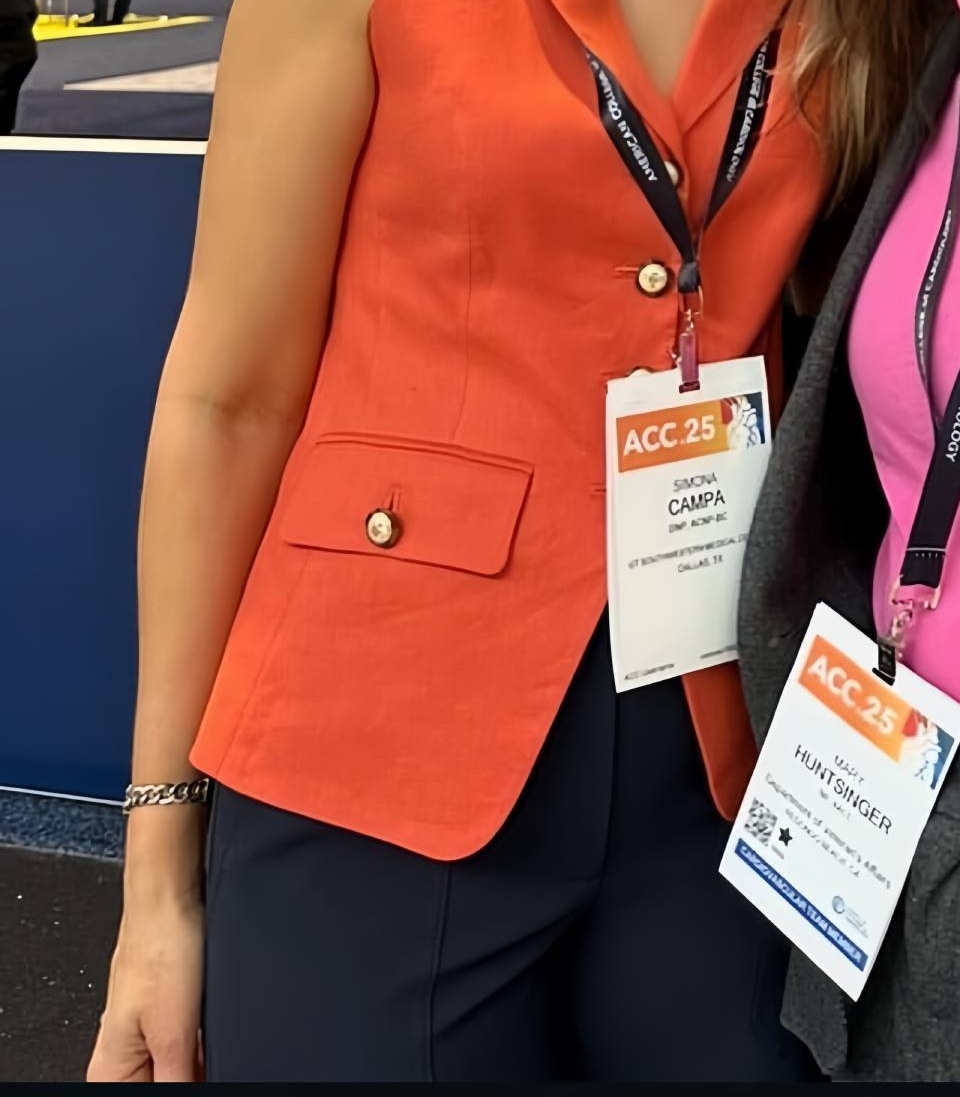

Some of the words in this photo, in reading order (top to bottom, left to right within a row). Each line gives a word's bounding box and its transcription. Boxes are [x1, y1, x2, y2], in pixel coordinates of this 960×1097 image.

[622, 414, 716, 456] ACC.25
[668, 489, 726, 516] CAMPA
[807, 654, 899, 736] ACC.25
[794, 744, 893, 835] HUNTSINGER
